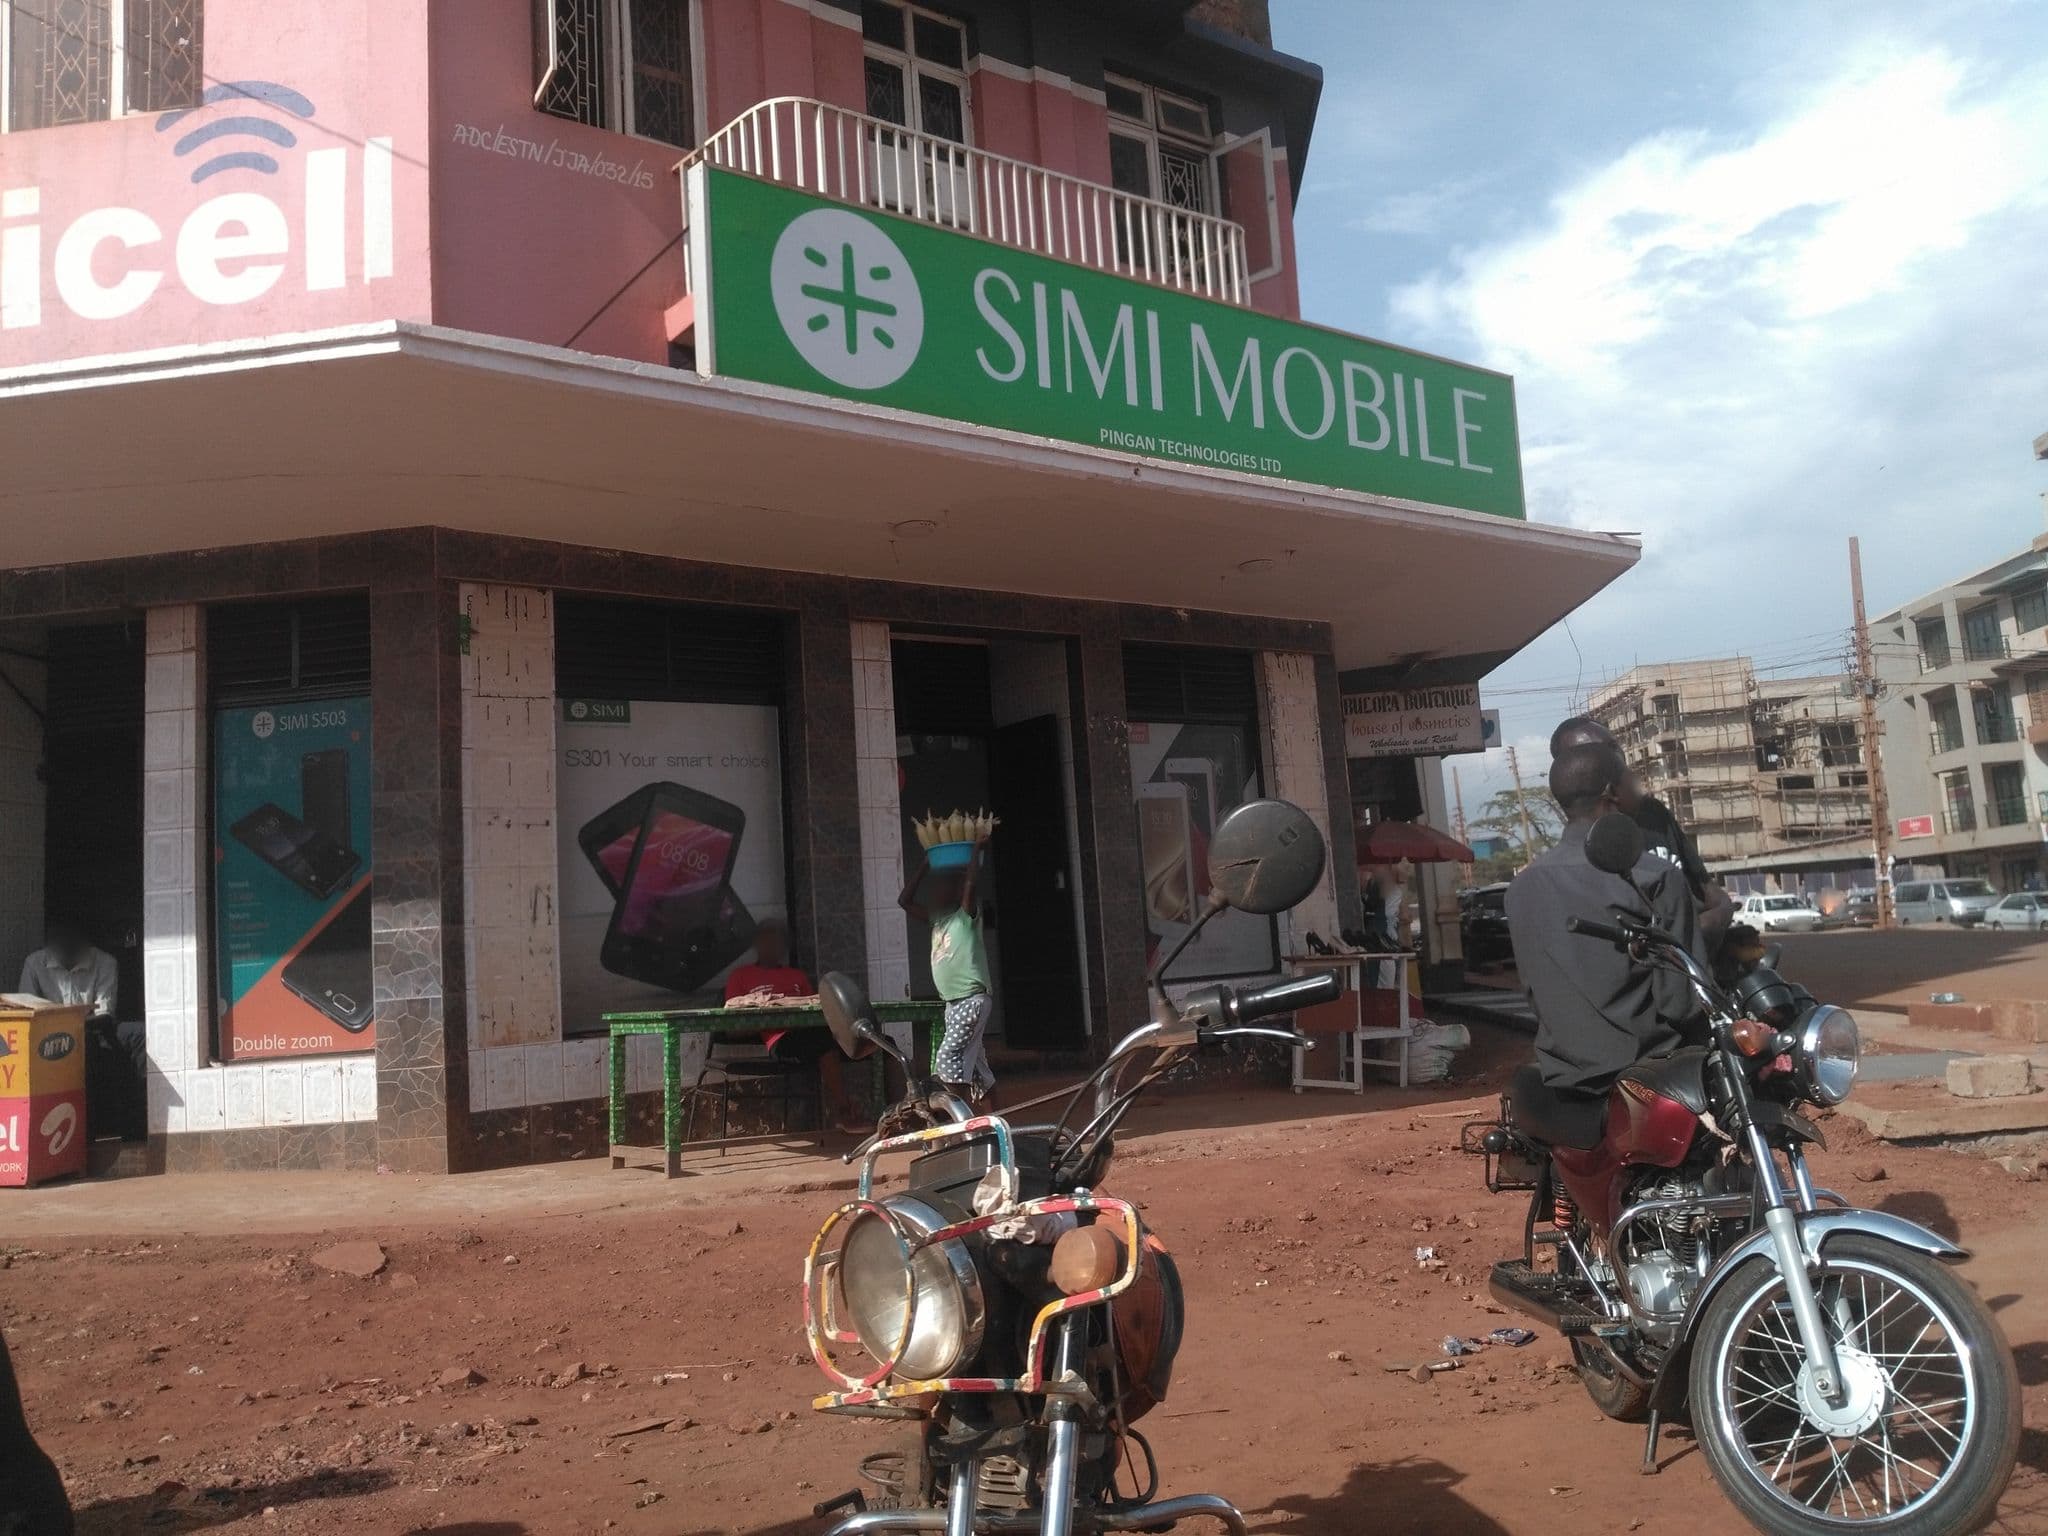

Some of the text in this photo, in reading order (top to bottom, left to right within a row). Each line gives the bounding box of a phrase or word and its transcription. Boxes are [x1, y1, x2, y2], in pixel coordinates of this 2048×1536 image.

[974, 267, 1494, 474] SIMI MOBILE
[1099, 428, 1281, 473] PINGAN TECHNOLOGIES LTD
[592, 703, 625, 717] SIMI
[279, 710, 347, 732] SIMI S503
[564, 750, 770, 768] S301 Your smart choice
[44, 1036, 70, 1057] MTN
[233, 1034, 333, 1052] Double zoom
